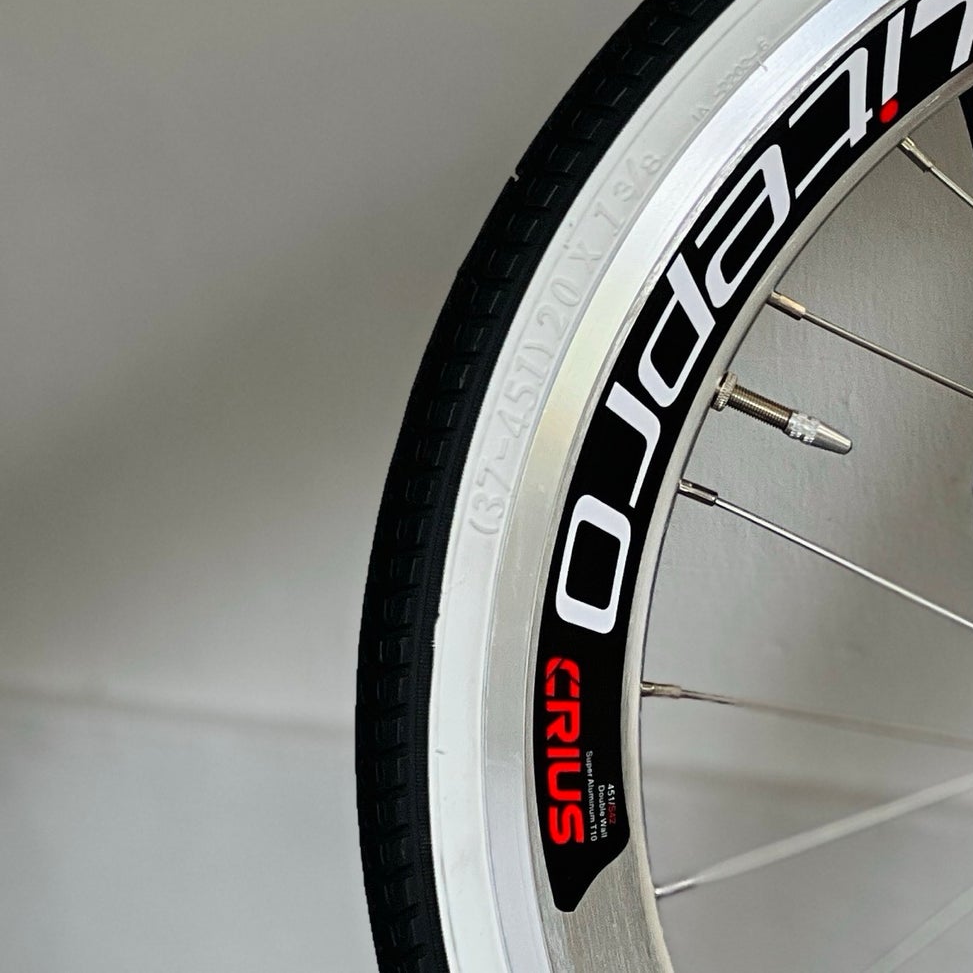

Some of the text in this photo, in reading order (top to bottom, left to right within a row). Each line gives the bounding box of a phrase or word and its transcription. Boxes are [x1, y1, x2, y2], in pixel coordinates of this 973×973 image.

[535, 276, 582, 343] 20
[546, 657, 584, 844] CRIUS
[585, 750, 598, 842] Super Aluminum T10
[598, 784, 609, 839] Double Wall
